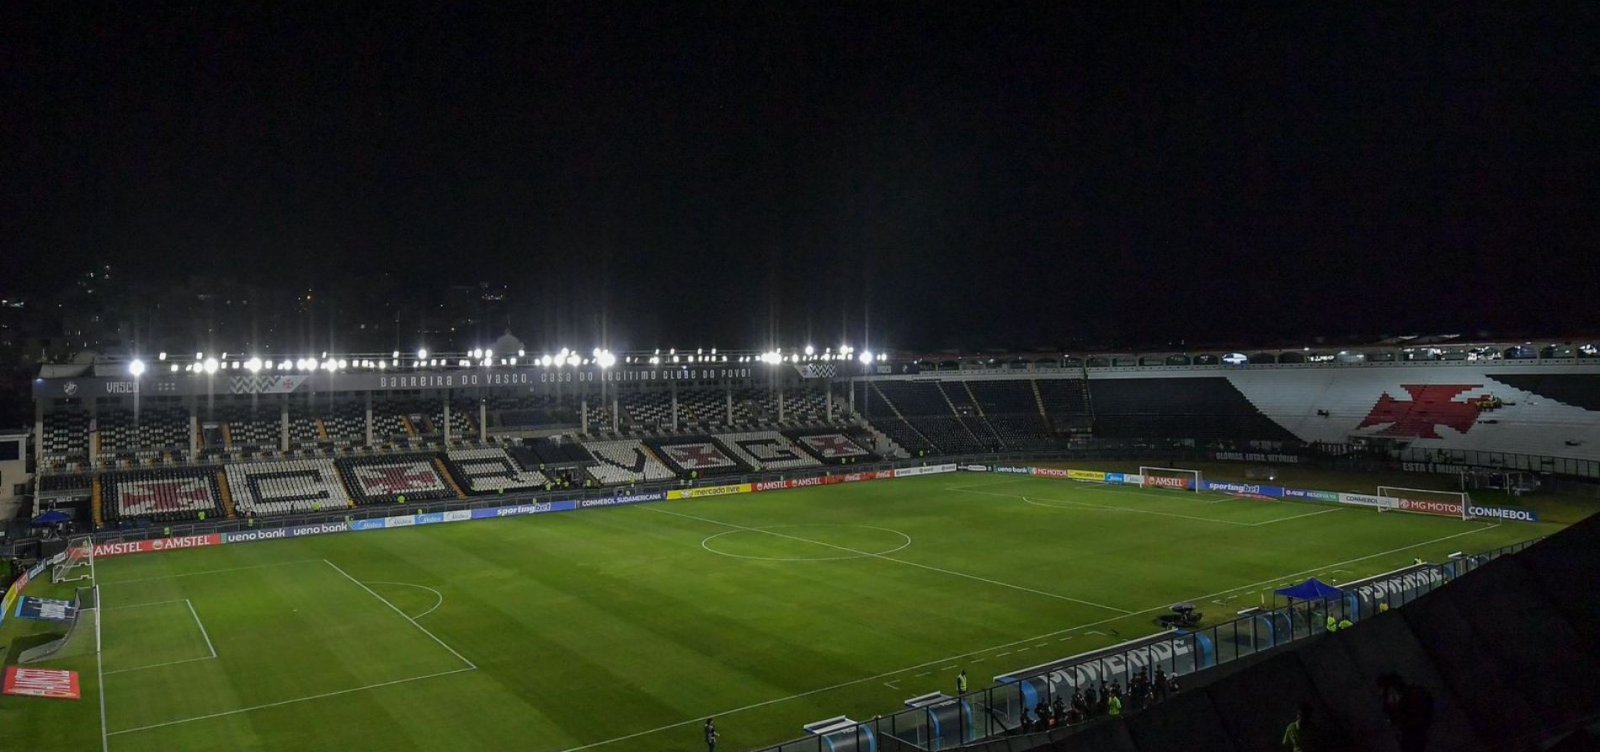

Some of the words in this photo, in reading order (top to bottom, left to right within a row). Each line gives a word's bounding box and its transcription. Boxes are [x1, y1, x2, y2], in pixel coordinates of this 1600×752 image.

[1402, 462, 1426, 472] ESTA
[763, 480, 787, 490] AMSTEL
[797, 477, 821, 486] AMSTEL
[1156, 477, 1183, 487] AMSTEL
[1209, 482, 1260, 494] sportingbet
[694, 487, 725, 496] mercado
[726, 486, 740, 494] livre
[582, 498, 615, 507] CONMEBOL
[617, 493, 661, 504] SUDAMERICANA
[1411, 500, 1426, 510] MG
[1427, 502, 1463, 513] MOTOR
[497, 502, 551, 516] sportingbet
[1468, 505, 1533, 521] CONMEBOL
[227, 532, 256, 543] ueno
[257, 528, 286, 540] bank
[293, 526, 320, 536] ueno
[321, 522, 348, 533] bank
[94, 542, 142, 556] AMSTEL
[165, 535, 210, 549] AMSTEL
[1037, 639, 1190, 694] POWERADE
